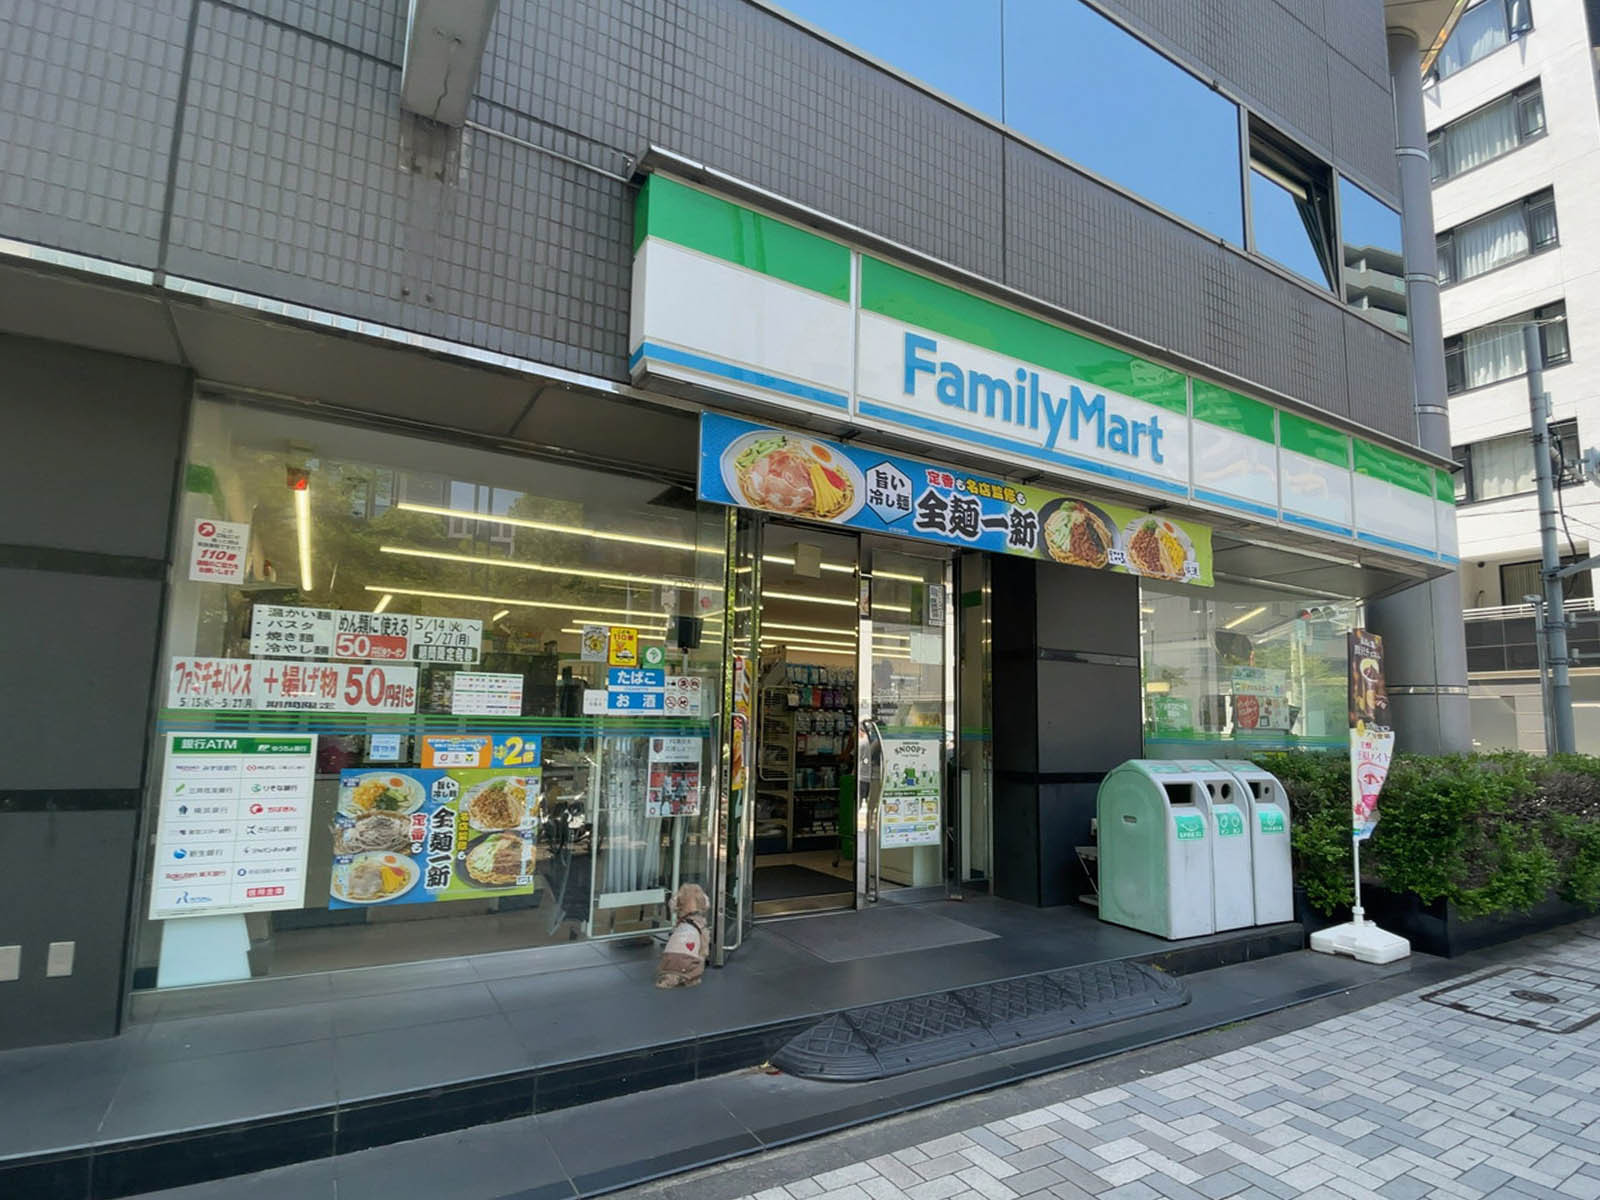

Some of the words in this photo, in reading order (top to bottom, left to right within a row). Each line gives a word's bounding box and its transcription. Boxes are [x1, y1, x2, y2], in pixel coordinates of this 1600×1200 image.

[904, 332, 1163, 464] FamilyMart
[875, 469, 905, 491] 旨い
[869, 488, 910, 512] 冷し麺
[916, 489, 1038, 549] 全麺一新
[338, 613, 409, 636] めん類に使える
[343, 666, 415, 708] 50円引き
[617, 670, 656, 685] たばこ
[616, 694, 656, 708] お酒
[180, 738, 238, 750] 銀行ATM
[426, 807, 456, 888] 全麺一新
